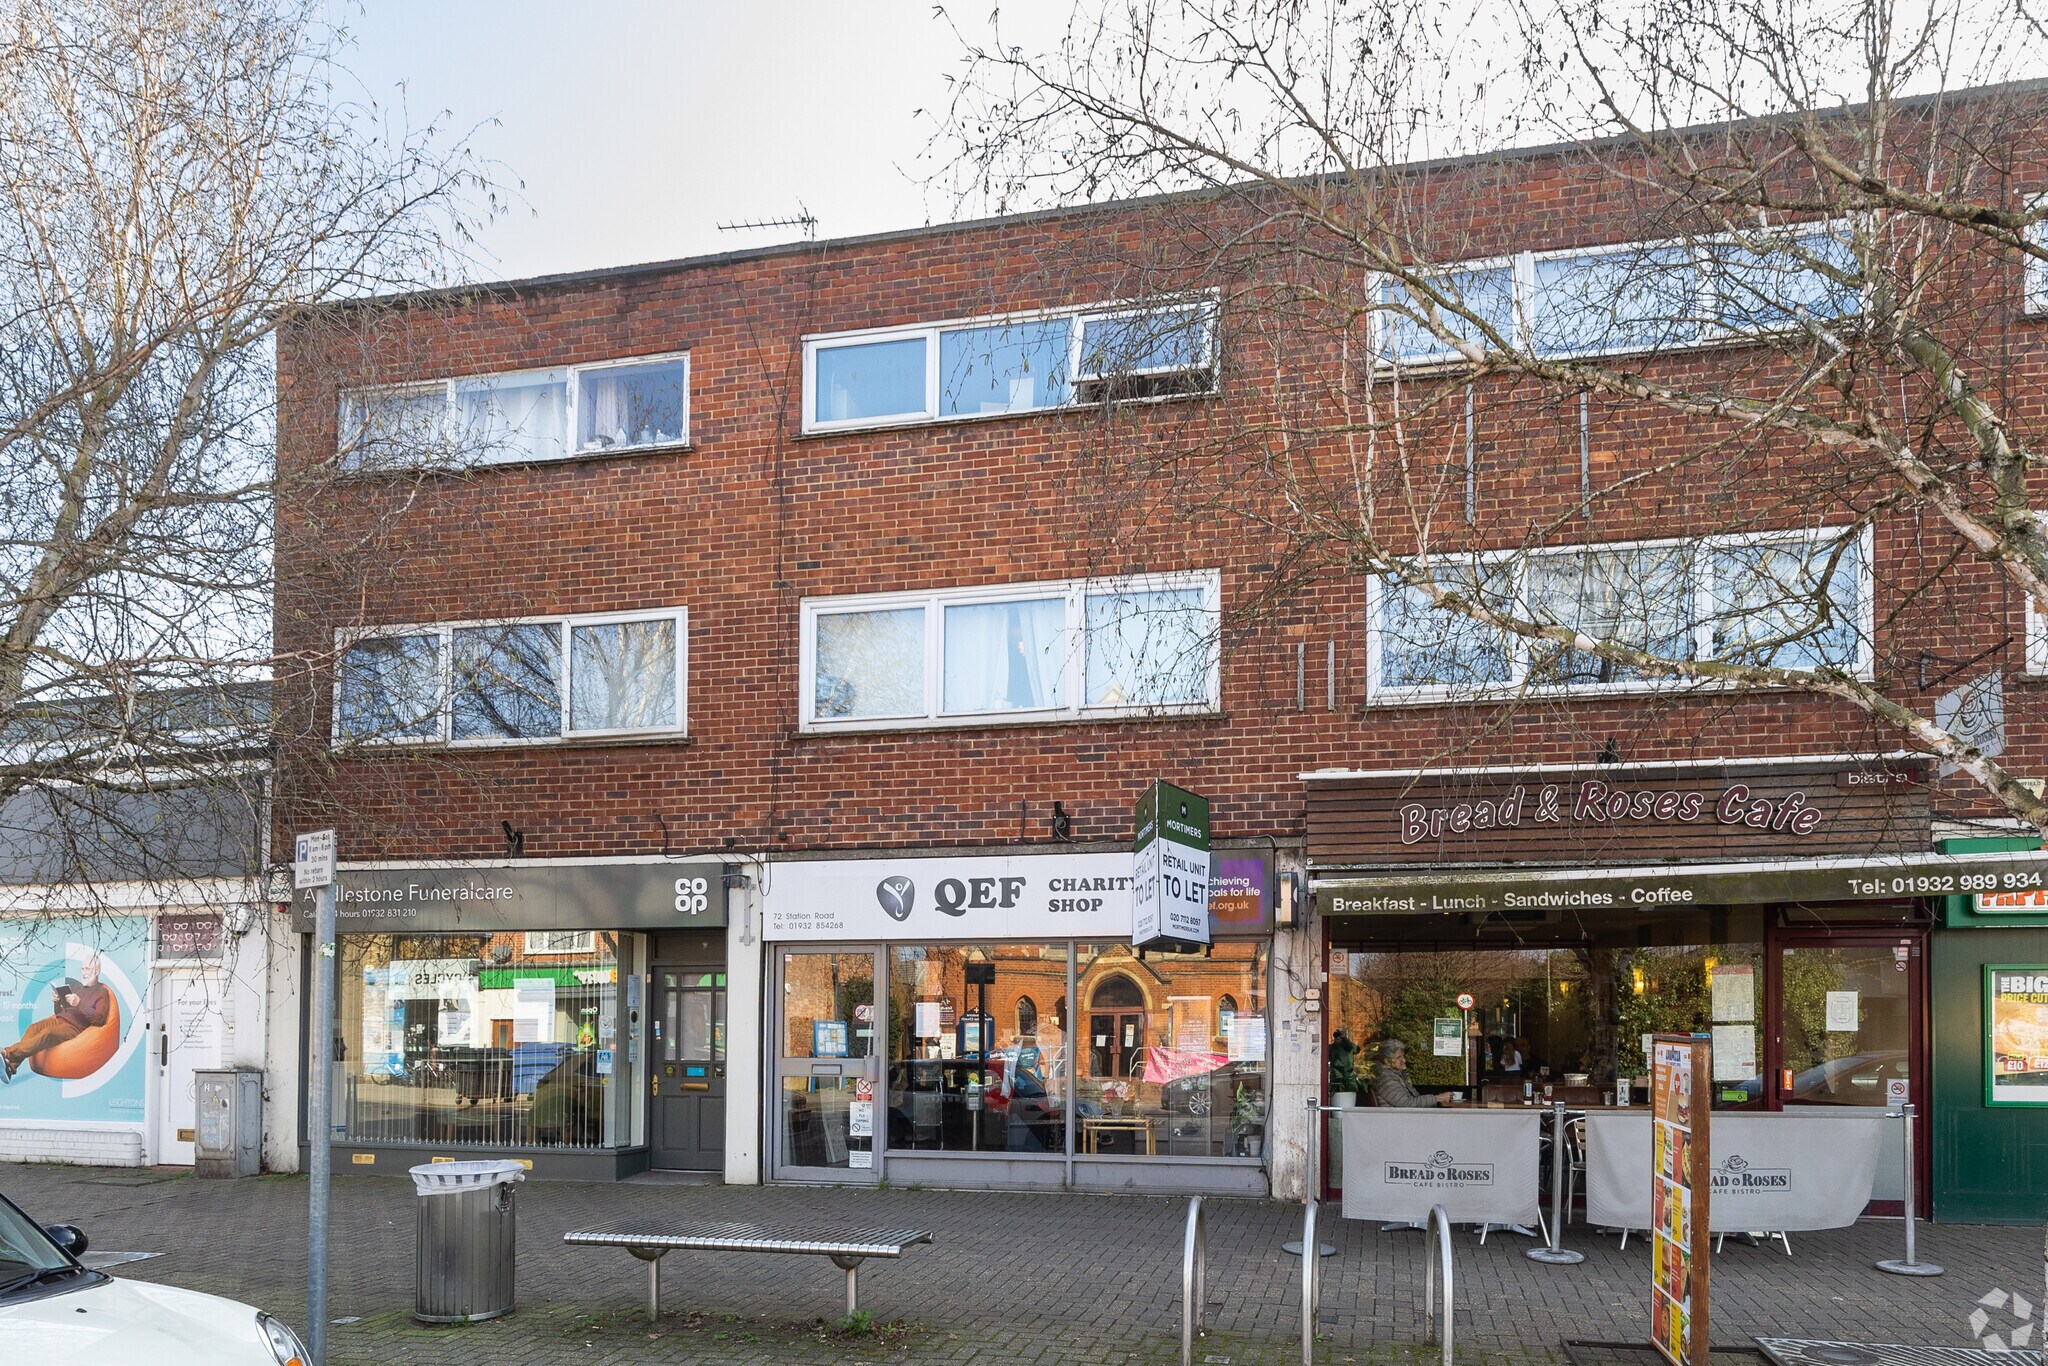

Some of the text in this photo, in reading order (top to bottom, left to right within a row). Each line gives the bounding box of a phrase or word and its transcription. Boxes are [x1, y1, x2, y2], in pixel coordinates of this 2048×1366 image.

[1400, 780, 1823, 845] Bread & Roses Cafe
[1167, 819, 1202, 839] MORTIMERS
[299, 842, 307, 862] P
[1163, 854, 1206, 877] RETAIL UNIT
[1163, 874, 1206, 905] TO LET
[1209, 876, 1250, 888] chieving
[1848, 872, 2043, 895] Tel: 01932 989 934
[303, 882, 514, 903] Alestone Funeralcare
[934, 876, 1027, 917] QEF
[1230, 887, 1244, 897] for
[1245, 886, 1261, 897] life
[1332, 896, 1416, 912] Breakfast
[1432, 895, 1486, 910] Lunch
[1503, 891, 1614, 908] Sandwiches
[1631, 887, 1693, 904] Coffee
[340, 910, 360, 918] hours
[362, 909, 385, 918] 01932
[387, 908, 401, 917] 831
[403, 908, 417, 917] 210
[1048, 898, 1103, 913] SHOP
[1209, 900, 1250, 912] ef.org.uk
[786, 912, 811, 920] Station
[814, 912, 835, 920] Road
[773, 921, 844, 930] Tel: 01932 854268
[2001, 976, 2048, 993] THE BIG
[2001, 993, 2028, 1004] PRICE
[1389, 1165, 1434, 1180] BREAD
[1447, 1168, 1490, 1181] ROSES
[1742, 1173, 1787, 1187] ROSES
